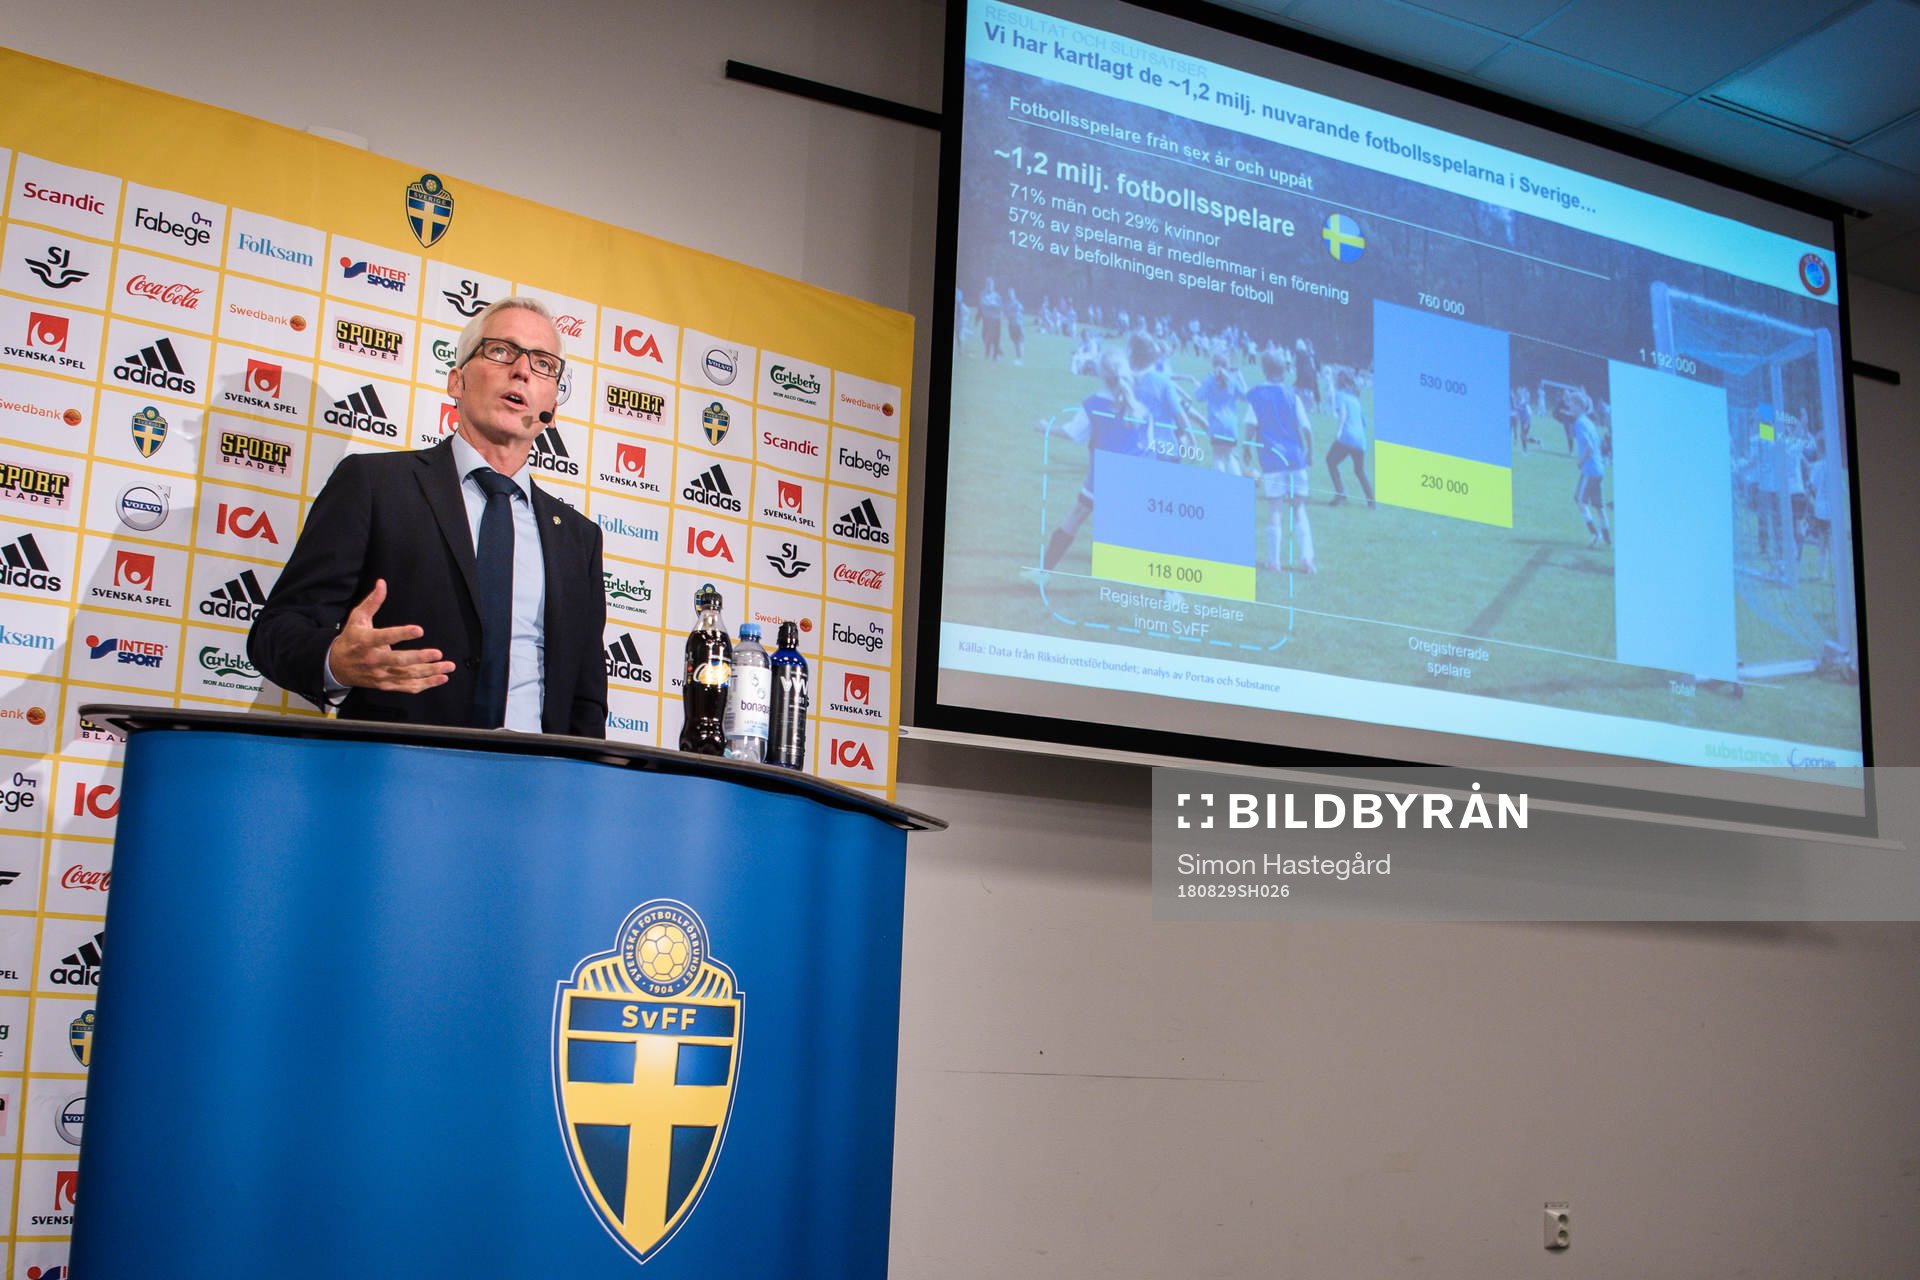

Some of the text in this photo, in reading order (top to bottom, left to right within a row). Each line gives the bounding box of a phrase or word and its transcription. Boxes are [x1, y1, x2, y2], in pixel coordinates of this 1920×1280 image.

[1072, 30, 1106, 48] OCH
[984, 22, 1005, 44] Vi
[1013, 30, 1048, 54] har
[1054, 41, 1134, 80] kartlagt
[1139, 63, 1162, 87] de
[1168, 78, 1210, 101] ~1,2
[1216, 89, 1256, 116] milj.
[1262, 103, 1360, 143] nuvarande
[1365, 130, 1505, 186] fotbollsspelarna
[1510, 173, 1515, 189] i
[1009, 95, 1314, 190] Fotbollsspelare från sex år och uppåt
[23, 181, 105, 215] Scandic
[994, 147, 1296, 237] ~1,2 milj. fotbollsspelare
[135, 207, 210, 246] Fabege
[1009, 183, 1221, 247] 71% män och 29% kvinnor
[47, 246, 71, 268] SJ
[238, 232, 313, 267] Folksam
[1008, 207, 1045, 229] 57%
[1050, 220, 1070, 234] av
[1075, 225, 1143, 252] spelarna
[1147, 241, 1164, 257] är
[1167, 246, 1257, 280] medlemmar
[1269, 273, 1287, 288] en
[1291, 275, 1349, 305] förening
[368, 263, 407, 281] INTER
[1008, 230, 1274, 305] 12% av befolkningen spelar fotboll
[367, 274, 406, 292] SPORT
[460, 279, 479, 299] SJ
[229, 303, 288, 326] Swedbank
[1418, 292, 1465, 316] 760 000
[336, 319, 403, 355] SPORT
[613, 325, 664, 364] ICA
[4, 346, 86, 370] SVENSKA SPEL
[338, 342, 398, 361] BLADET
[113, 363, 196, 395] adidas
[770, 365, 820, 394] Carlsberg
[1675, 359, 1696, 376] 000
[1419, 373, 1468, 396] 530 000
[224, 392, 298, 415] SVENSKA SPEL
[607, 385, 664, 417] SPORT
[840, 393, 881, 412] Swedbank
[323, 406, 398, 438] adidas
[609, 406, 662, 422] BLADET
[221, 432, 292, 467] SPORT
[763, 431, 819, 456] Scandic
[1178, 445, 1205, 461] 000
[223, 456, 286, 474] BLADET
[527, 451, 579, 476] didas
[839, 448, 890, 478] Fabege
[600, 473, 660, 493] SVENSKA SPEL
[1421, 474, 1469, 496] 230 000
[4, 489, 64, 506] LADET
[123, 501, 162, 512] VOLVO
[683, 488, 741, 512] adidas
[1147, 498, 1205, 520] 314 000
[216, 503, 279, 545] ICA
[597, 514, 659, 542] Folksam
[763, 508, 815, 527] SVENSKA SPEL
[687, 526, 734, 563] ICA
[832, 523, 890, 544] adidas
[781, 542, 798, 560] SJ
[1148, 562, 1203, 584] 118 000
[91, 587, 172, 607] SVENSKA SPEL
[1099, 586, 1244, 622] Registrerade spelare
[199, 600, 264, 621] adid
[755, 612, 797, 626] Swedb
[0, 625, 55, 650] ksam
[832, 623, 884, 652] Fabege
[1134, 614, 1210, 638] inom SvFF
[119, 639, 164, 656] INTER
[199, 646, 258, 672] Carlsbe
[1408, 636, 1489, 662] Oregistrerade
[117, 652, 163, 668] SPORT
[605, 660, 652, 683] didas
[988, 645, 1013, 657] Data
[1015, 647, 1035, 660] från
[1142, 665, 1170, 679] analys
[1172, 672, 1183, 680] av
[1185, 671, 1214, 685] Portas
[1216, 676, 1233, 686] och
[1235, 677, 1281, 693] Substance
[1427, 661, 1472, 679] spelare
[608, 711, 649, 732] ksam
[830, 703, 882, 718] SVENSKA SPEL
[82, 731, 127, 743] BLA
[830, 739, 874, 771] ICA
[73, 782, 121, 820] IC
[626, 911, 700, 985] SVENSKA FOTBOLLFÖRBUNDET
[649, 984, 673, 994] 1904
[622, 1005, 697, 1031] SvFF
[31, 1215, 75, 1225] SVENS
